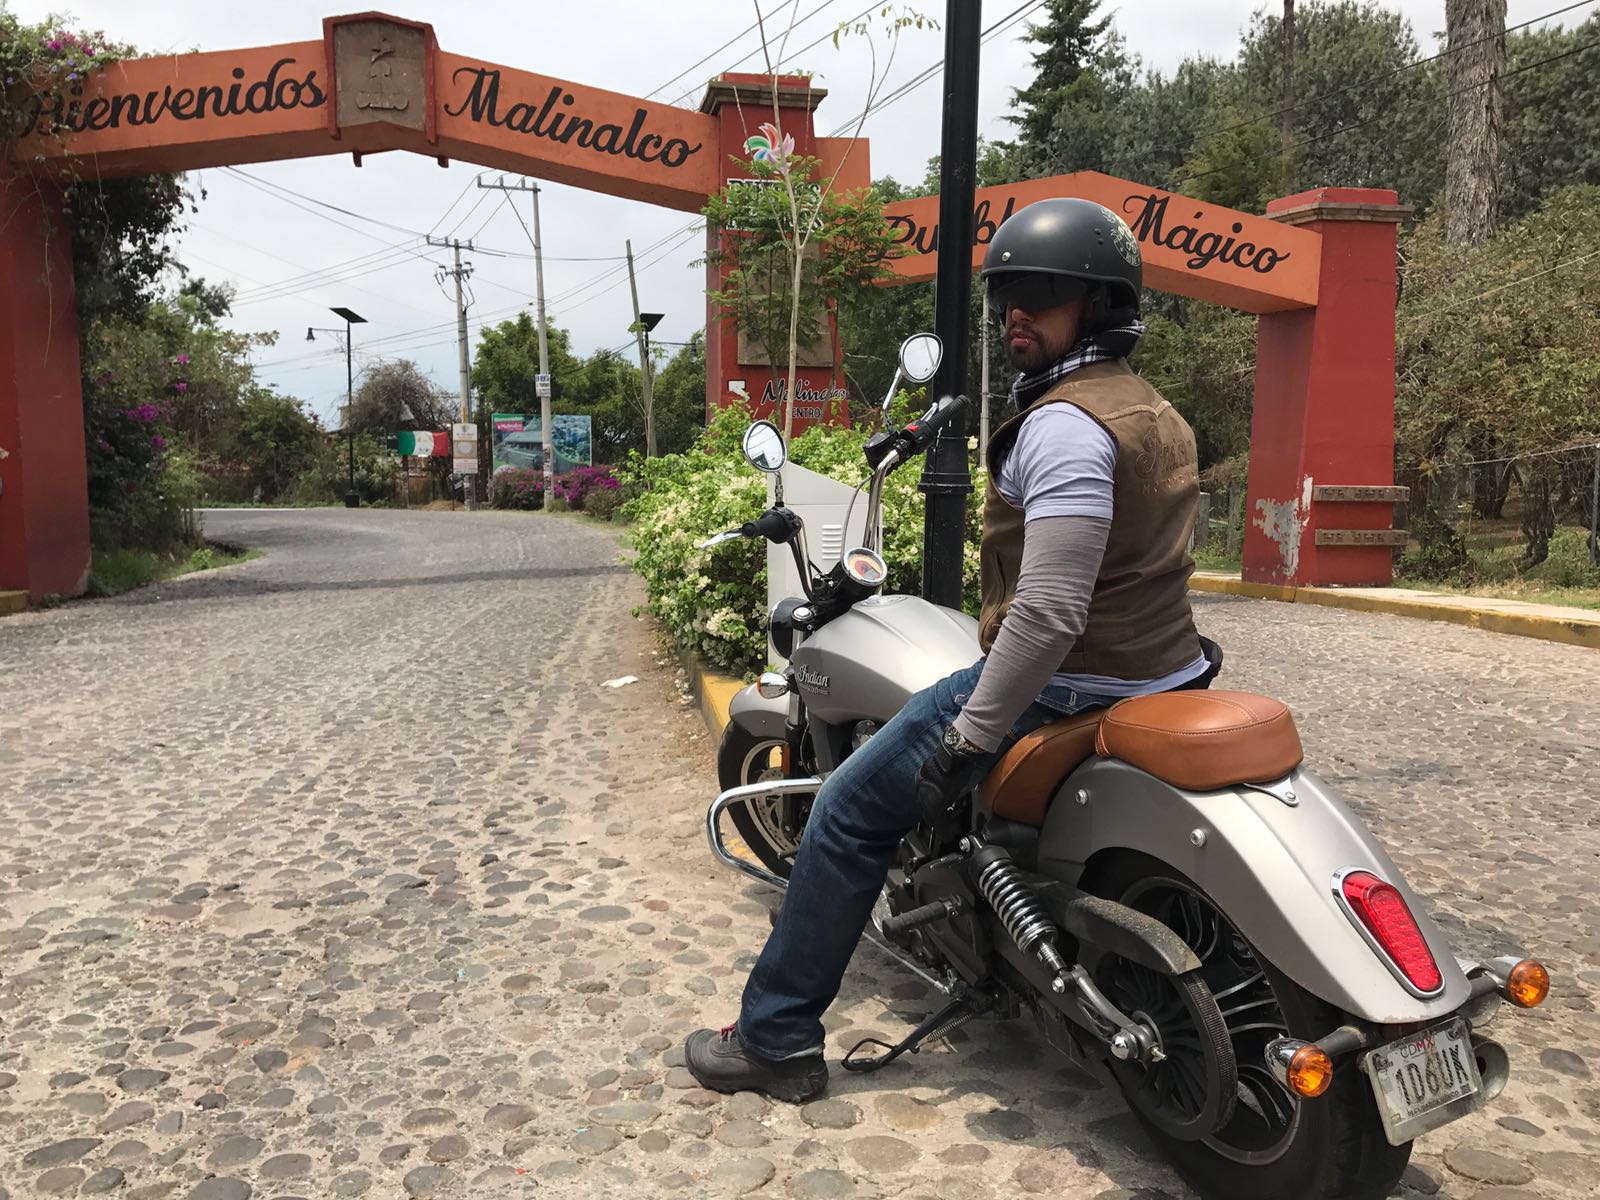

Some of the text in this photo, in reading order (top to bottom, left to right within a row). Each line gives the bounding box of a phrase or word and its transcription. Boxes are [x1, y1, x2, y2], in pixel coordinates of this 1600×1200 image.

[16, 58, 327, 138] Bienvenidos
[444, 67, 702, 168] Malinalco
[856, 194, 1291, 273] Publ Mágico
[791, 406, 822, 419] ENTRO
[797, 664, 830, 687] Indian
[1400, 1036, 1435, 1059] CDMX
